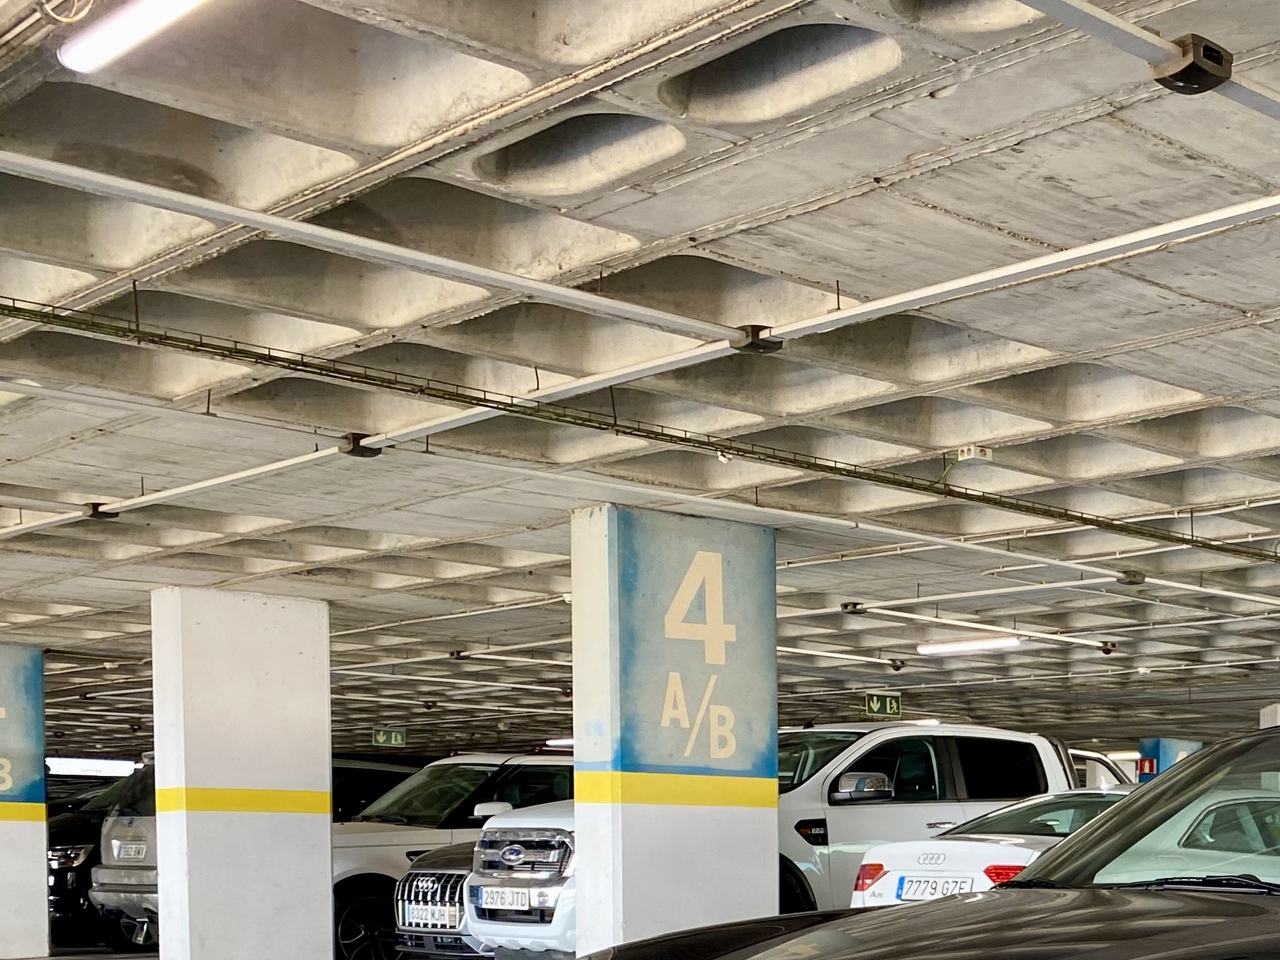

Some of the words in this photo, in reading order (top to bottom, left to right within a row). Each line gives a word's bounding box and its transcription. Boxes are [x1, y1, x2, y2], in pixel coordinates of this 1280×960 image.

[664, 550, 737, 666] 4
[660, 671, 737, 760] A/B
[484, 888, 506, 906] 2976
[508, 889, 527, 907] JTD
[904, 880, 938, 896] 7779
